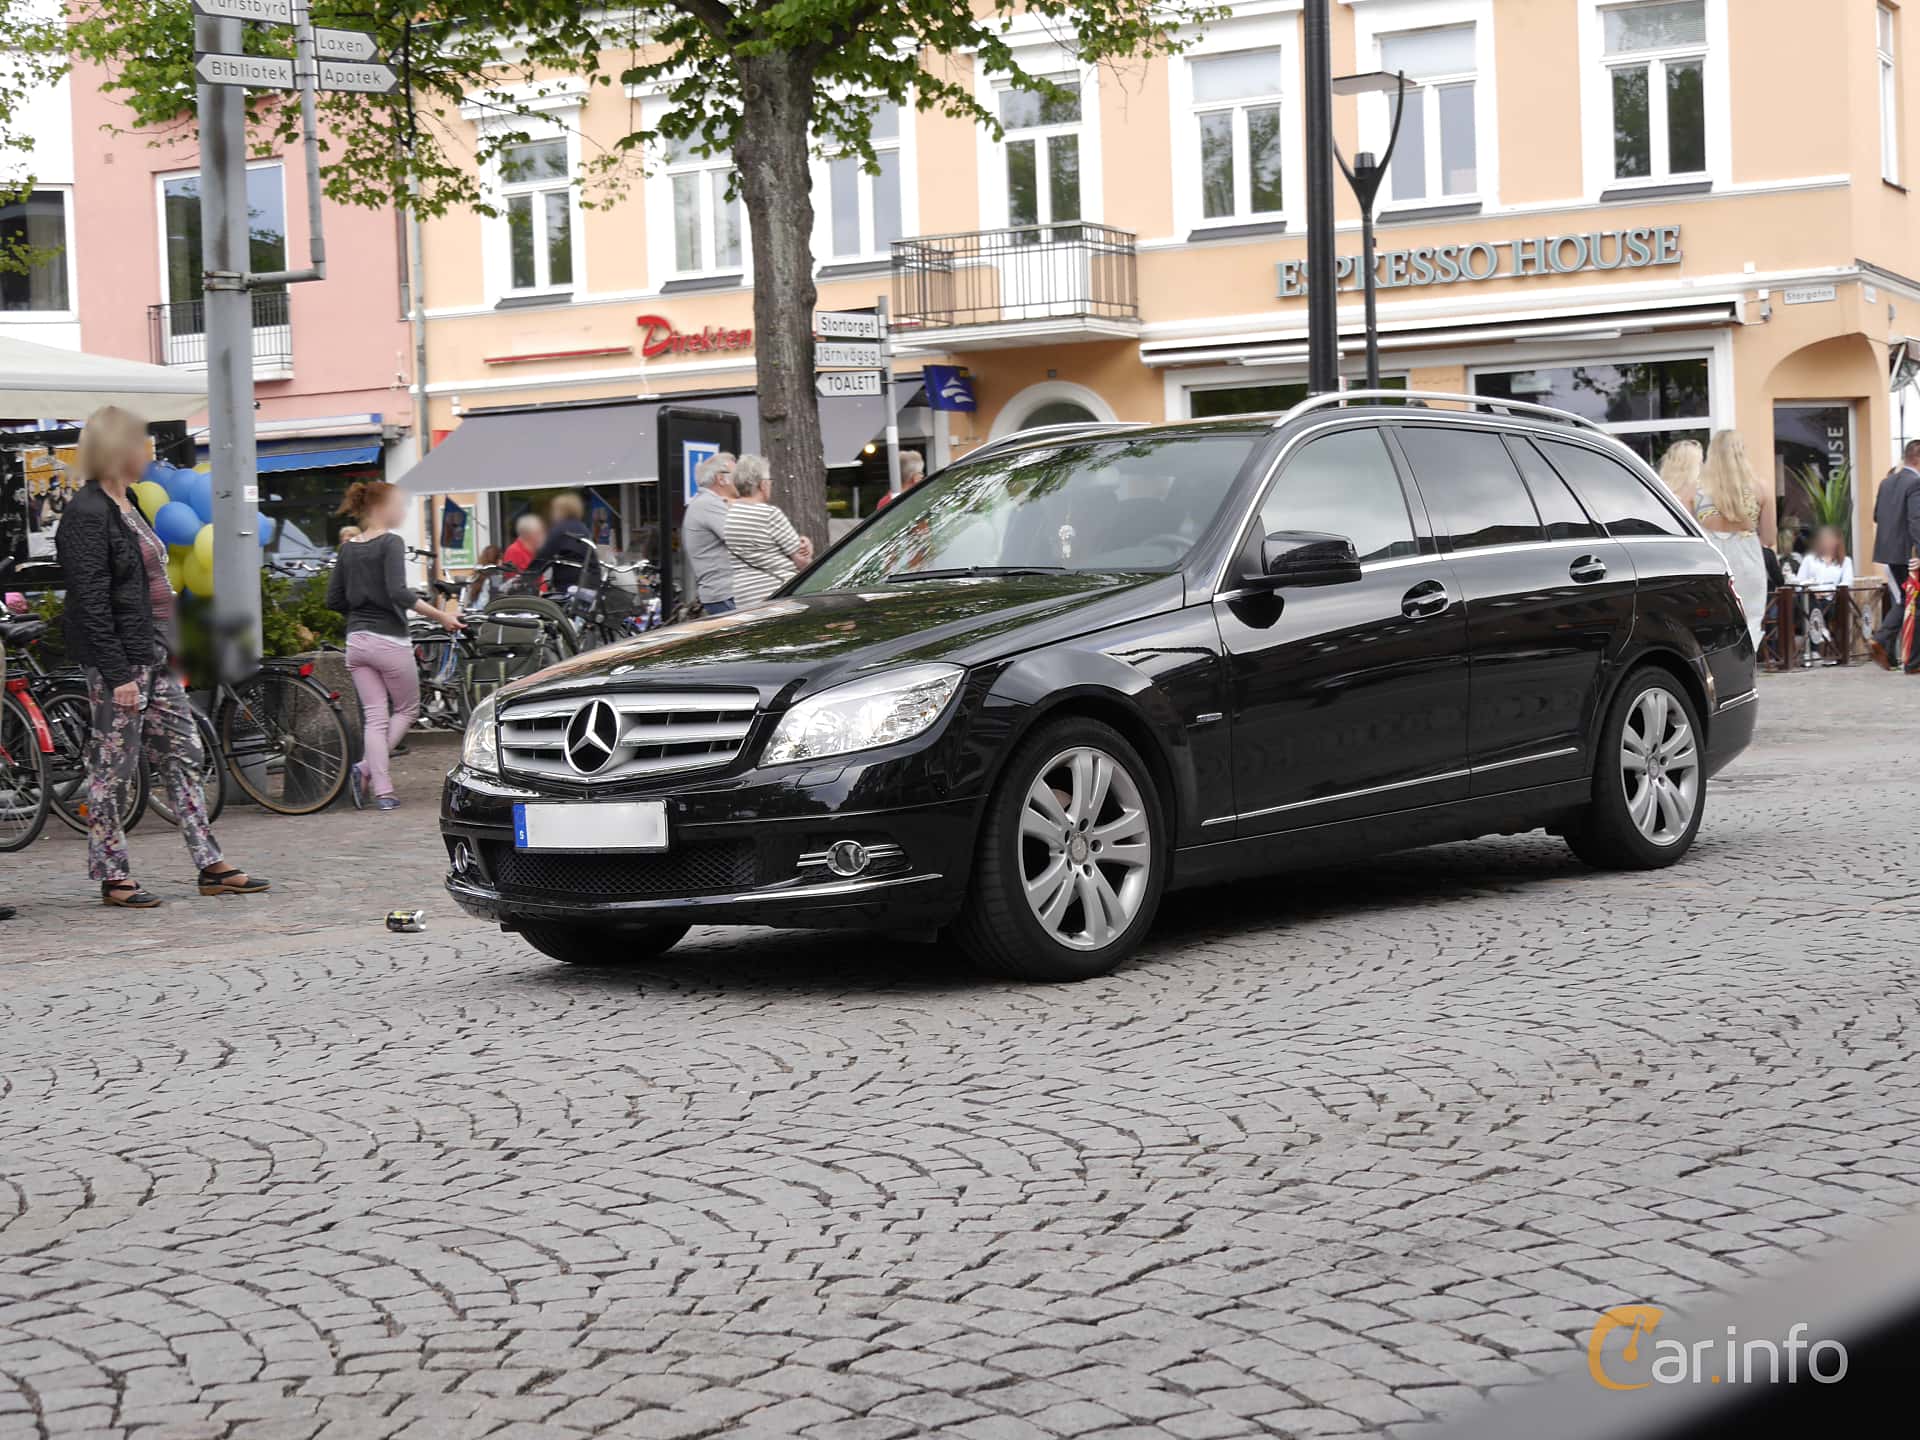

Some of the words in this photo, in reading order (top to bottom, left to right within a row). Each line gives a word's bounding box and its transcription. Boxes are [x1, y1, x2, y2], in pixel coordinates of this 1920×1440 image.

[320, 34, 363, 52] Laxen
[211, 61, 288, 81] Bibliotek
[325, 68, 382, 85] Apotek
[1277, 243, 1498, 298] EPRESSO
[1511, 225, 1681, 277] HOUSE
[636, 315, 752, 357] Direkten
[821, 316, 875, 337] Stortorget
[827, 375, 876, 391] TOALETT
